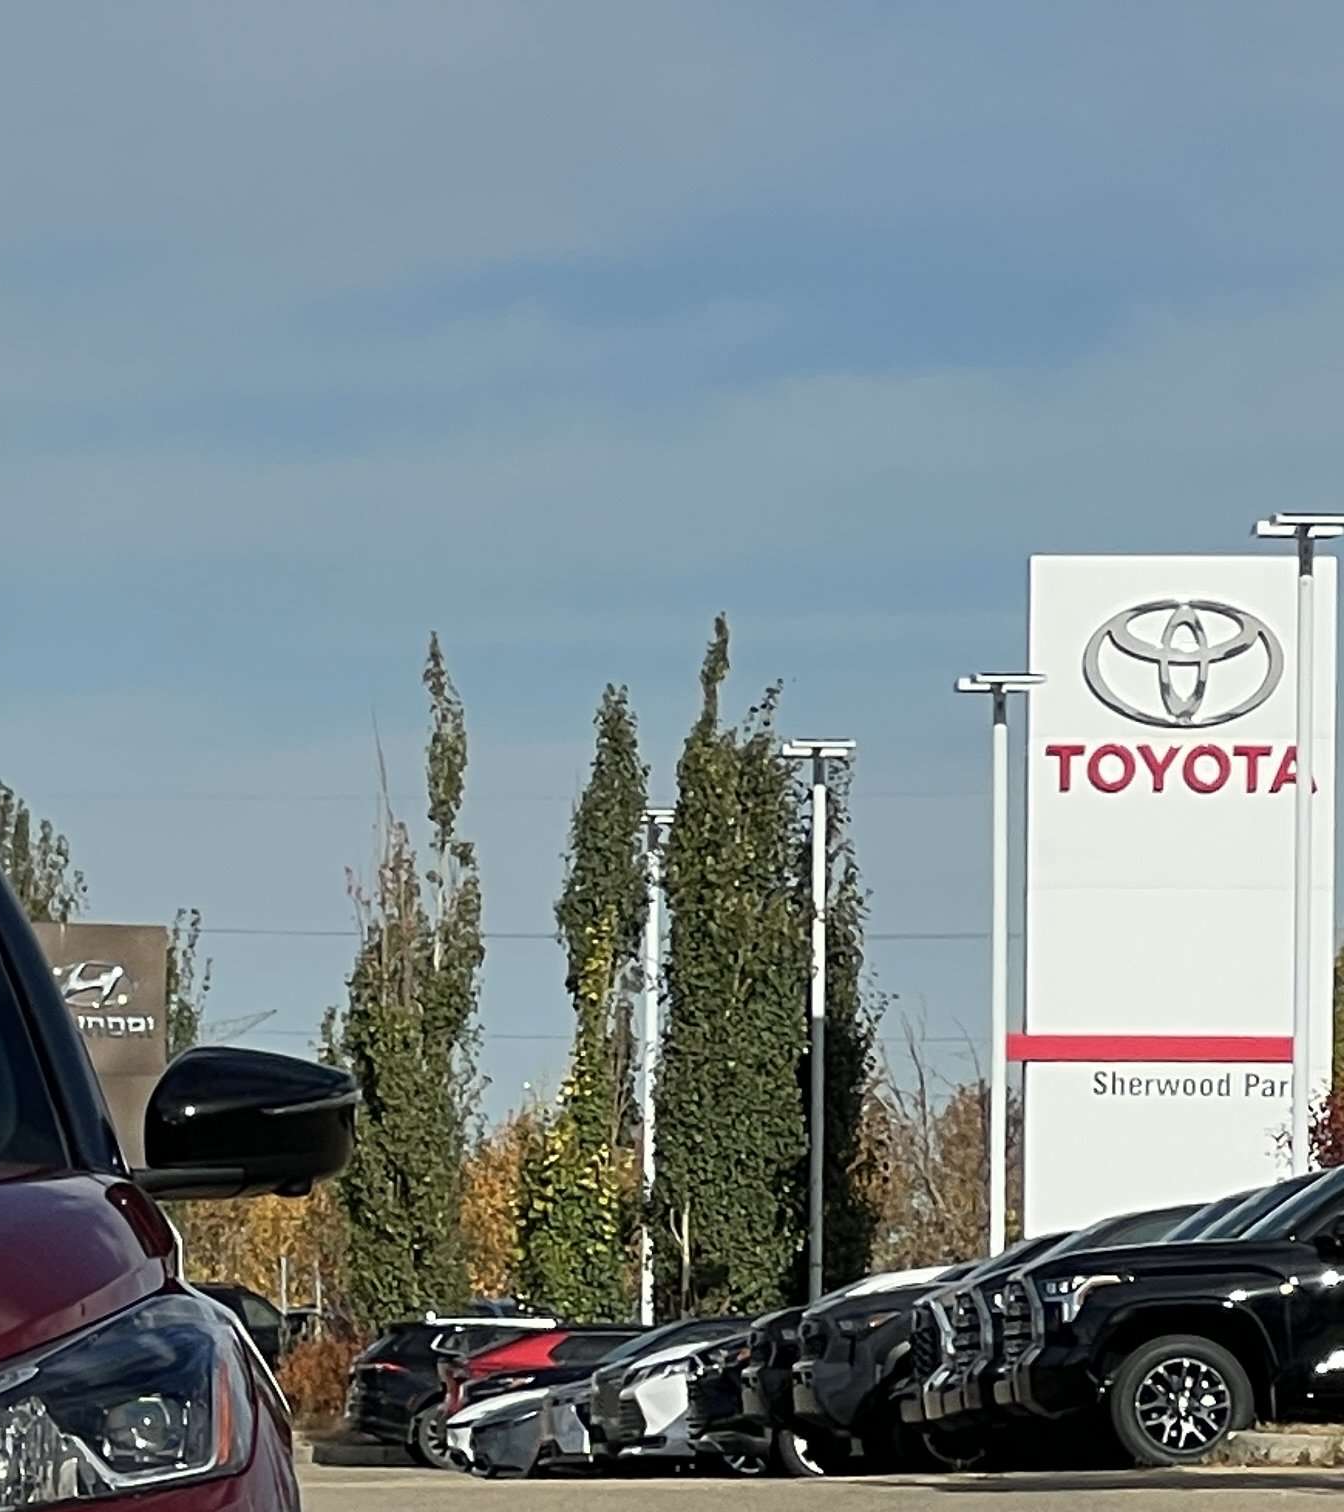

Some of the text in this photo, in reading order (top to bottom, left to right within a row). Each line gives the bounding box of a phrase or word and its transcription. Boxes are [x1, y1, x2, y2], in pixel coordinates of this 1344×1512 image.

[1045, 743, 1318, 794] TOYOTA
[1092, 1070, 1294, 1098] Sherwood Par
